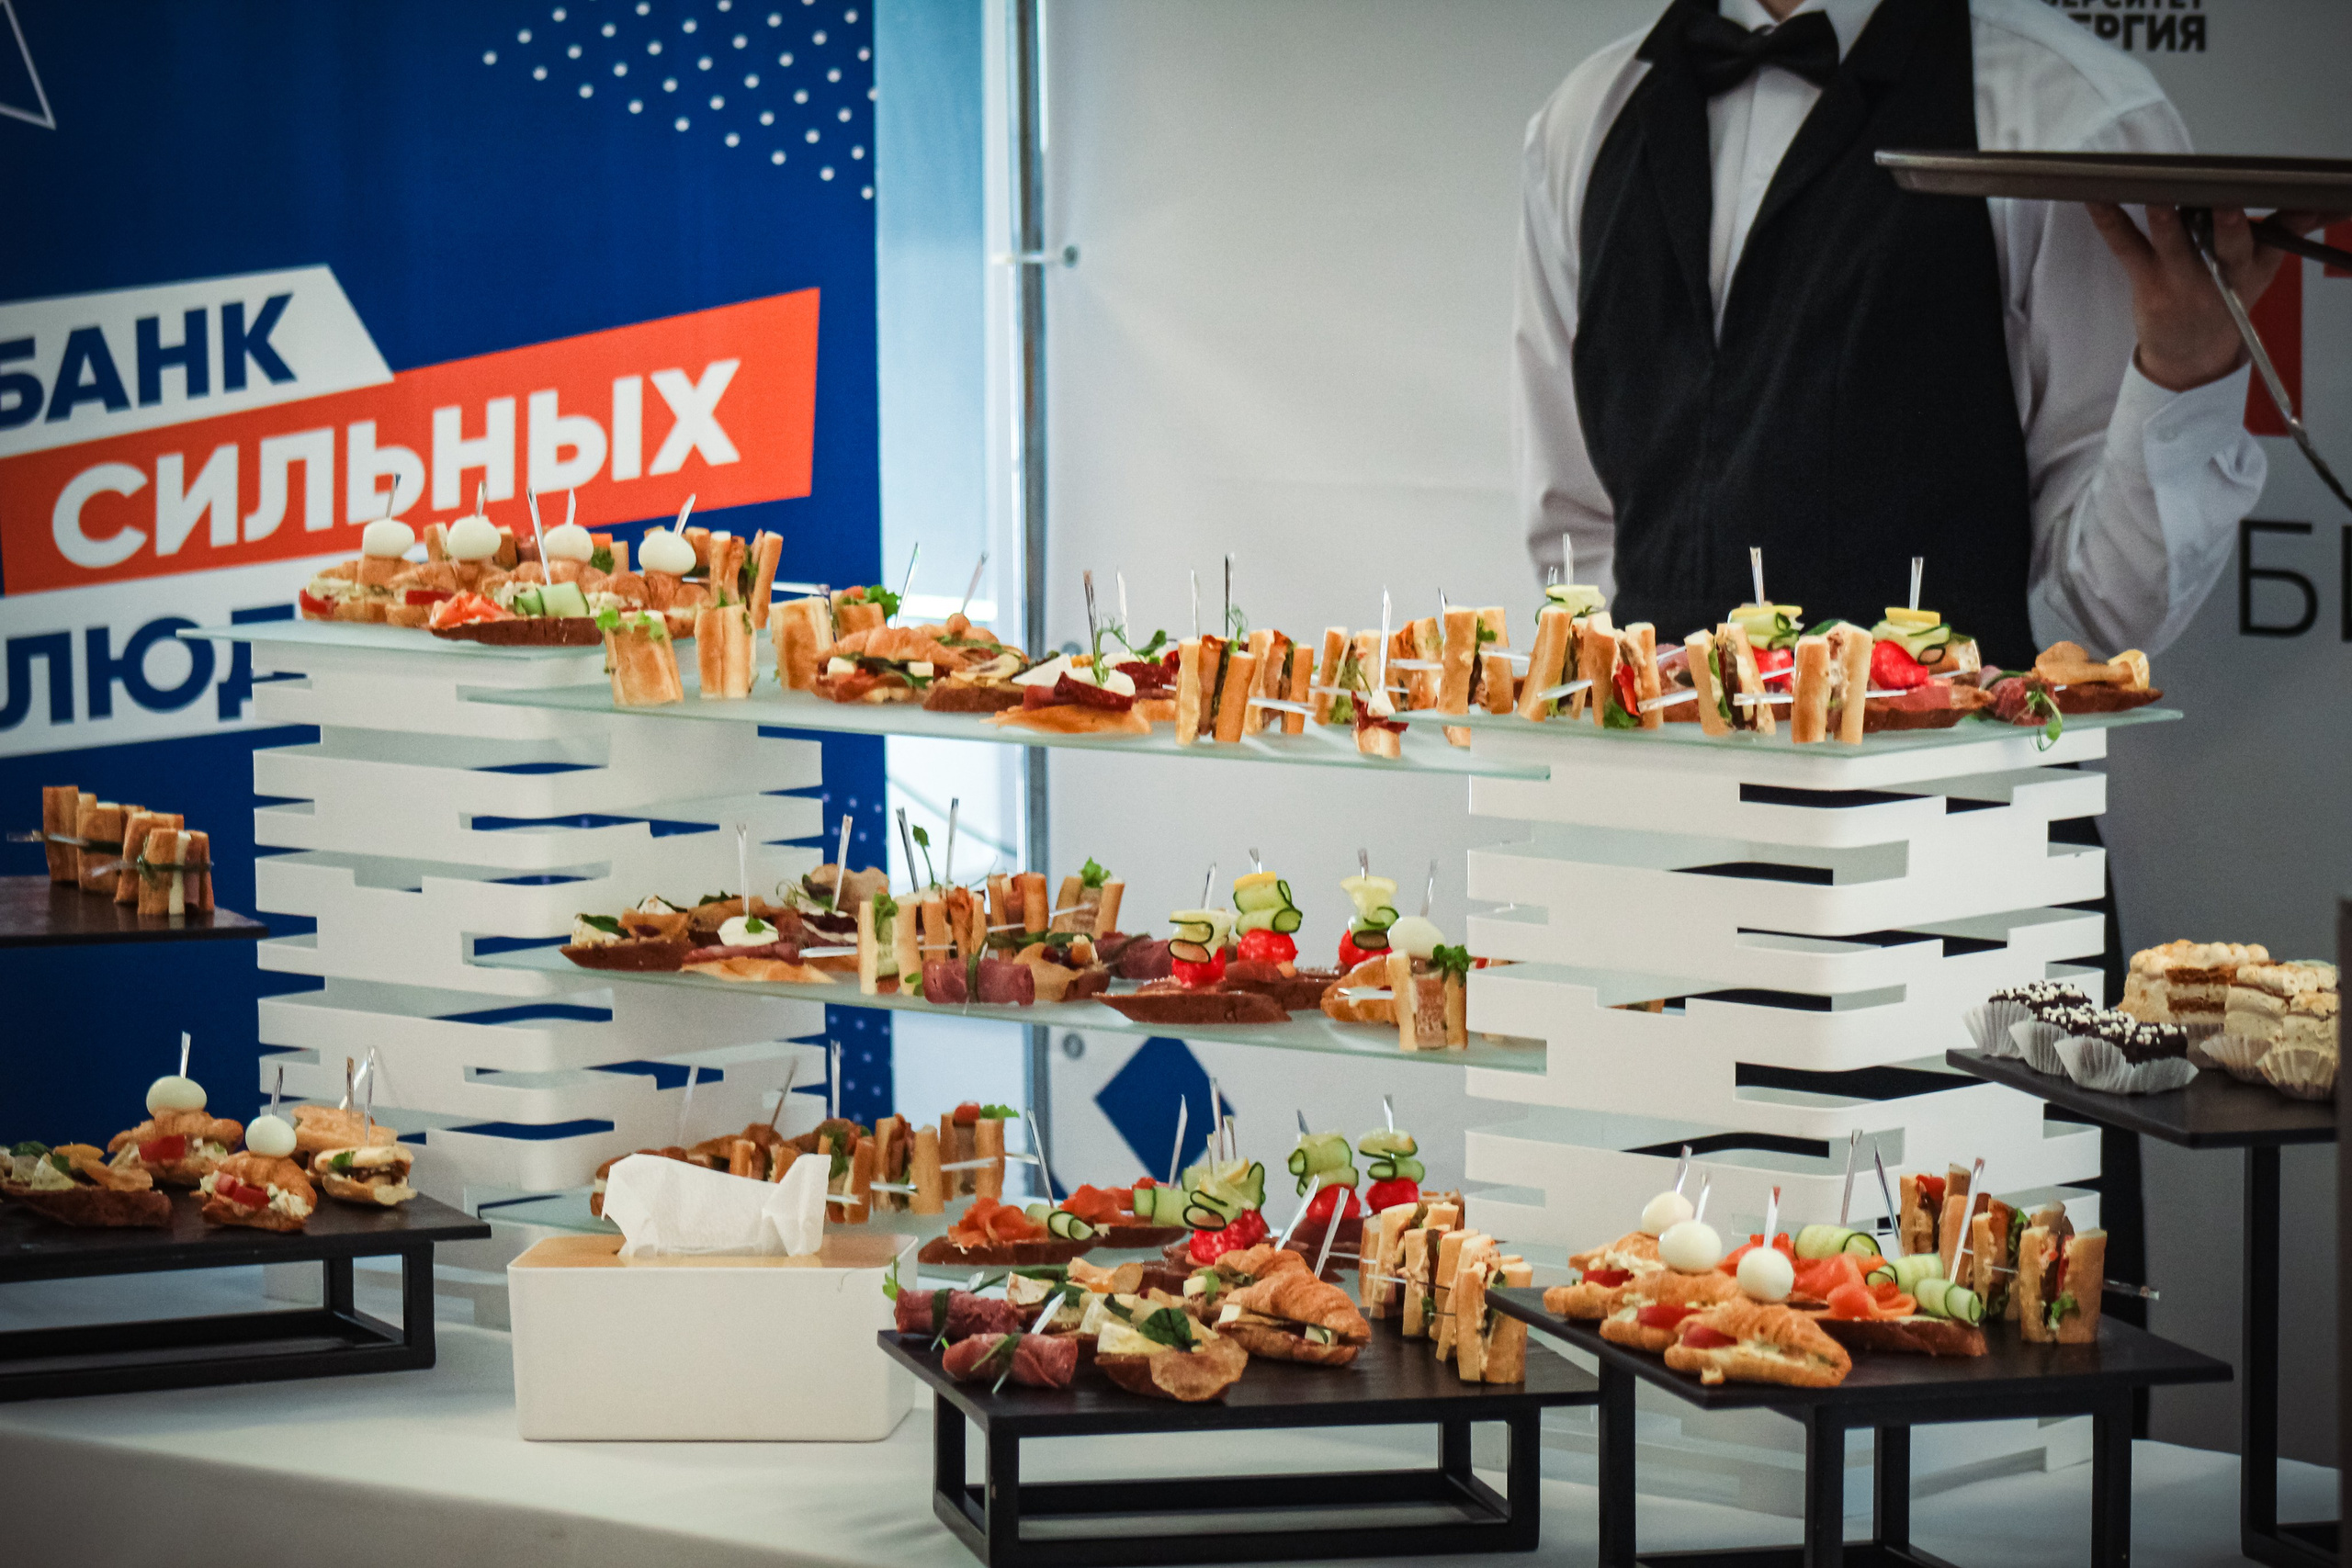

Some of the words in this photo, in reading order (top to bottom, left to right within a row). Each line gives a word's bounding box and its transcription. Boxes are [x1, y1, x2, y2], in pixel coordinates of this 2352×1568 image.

[0, 292, 298, 432] БАНК
[51, 358, 741, 568] СИЛЬНЫХ
[2238, 517, 2352, 642] Б
